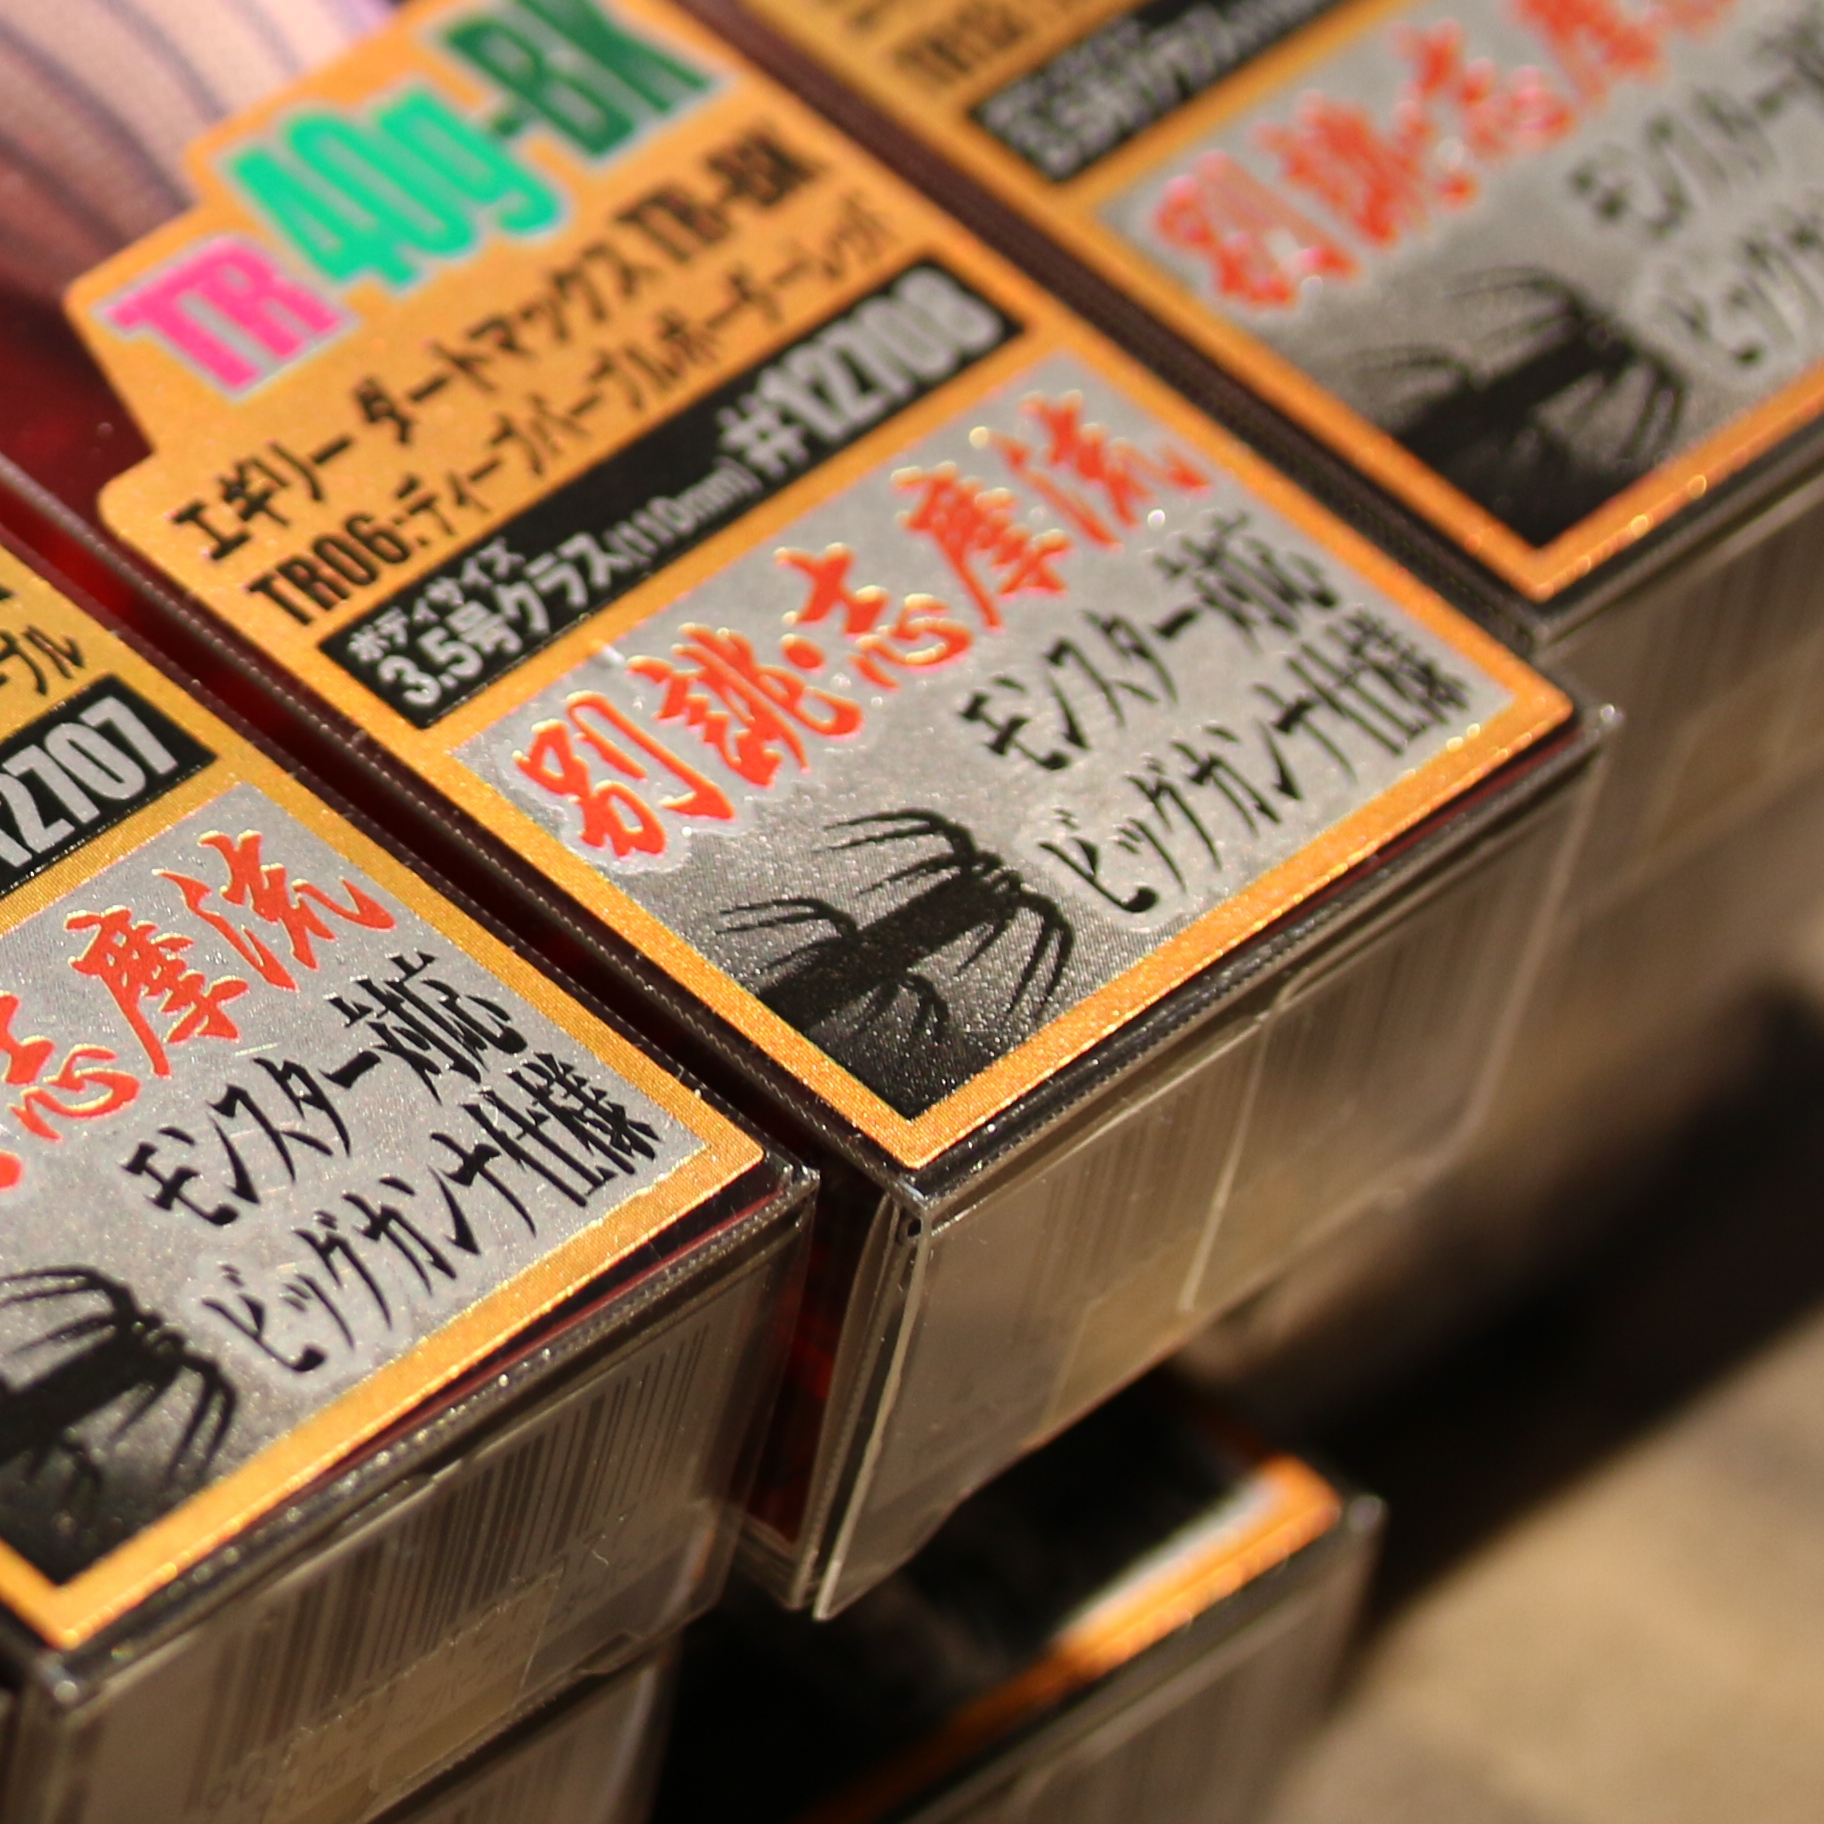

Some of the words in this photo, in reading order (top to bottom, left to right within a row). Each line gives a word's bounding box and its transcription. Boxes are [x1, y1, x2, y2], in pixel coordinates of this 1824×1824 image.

[174, 434, 354, 559] エギリー
[121, 951, 529, 1226] モンスター対応
[204, 1053, 662, 1373] ビッグカンナ仕様
